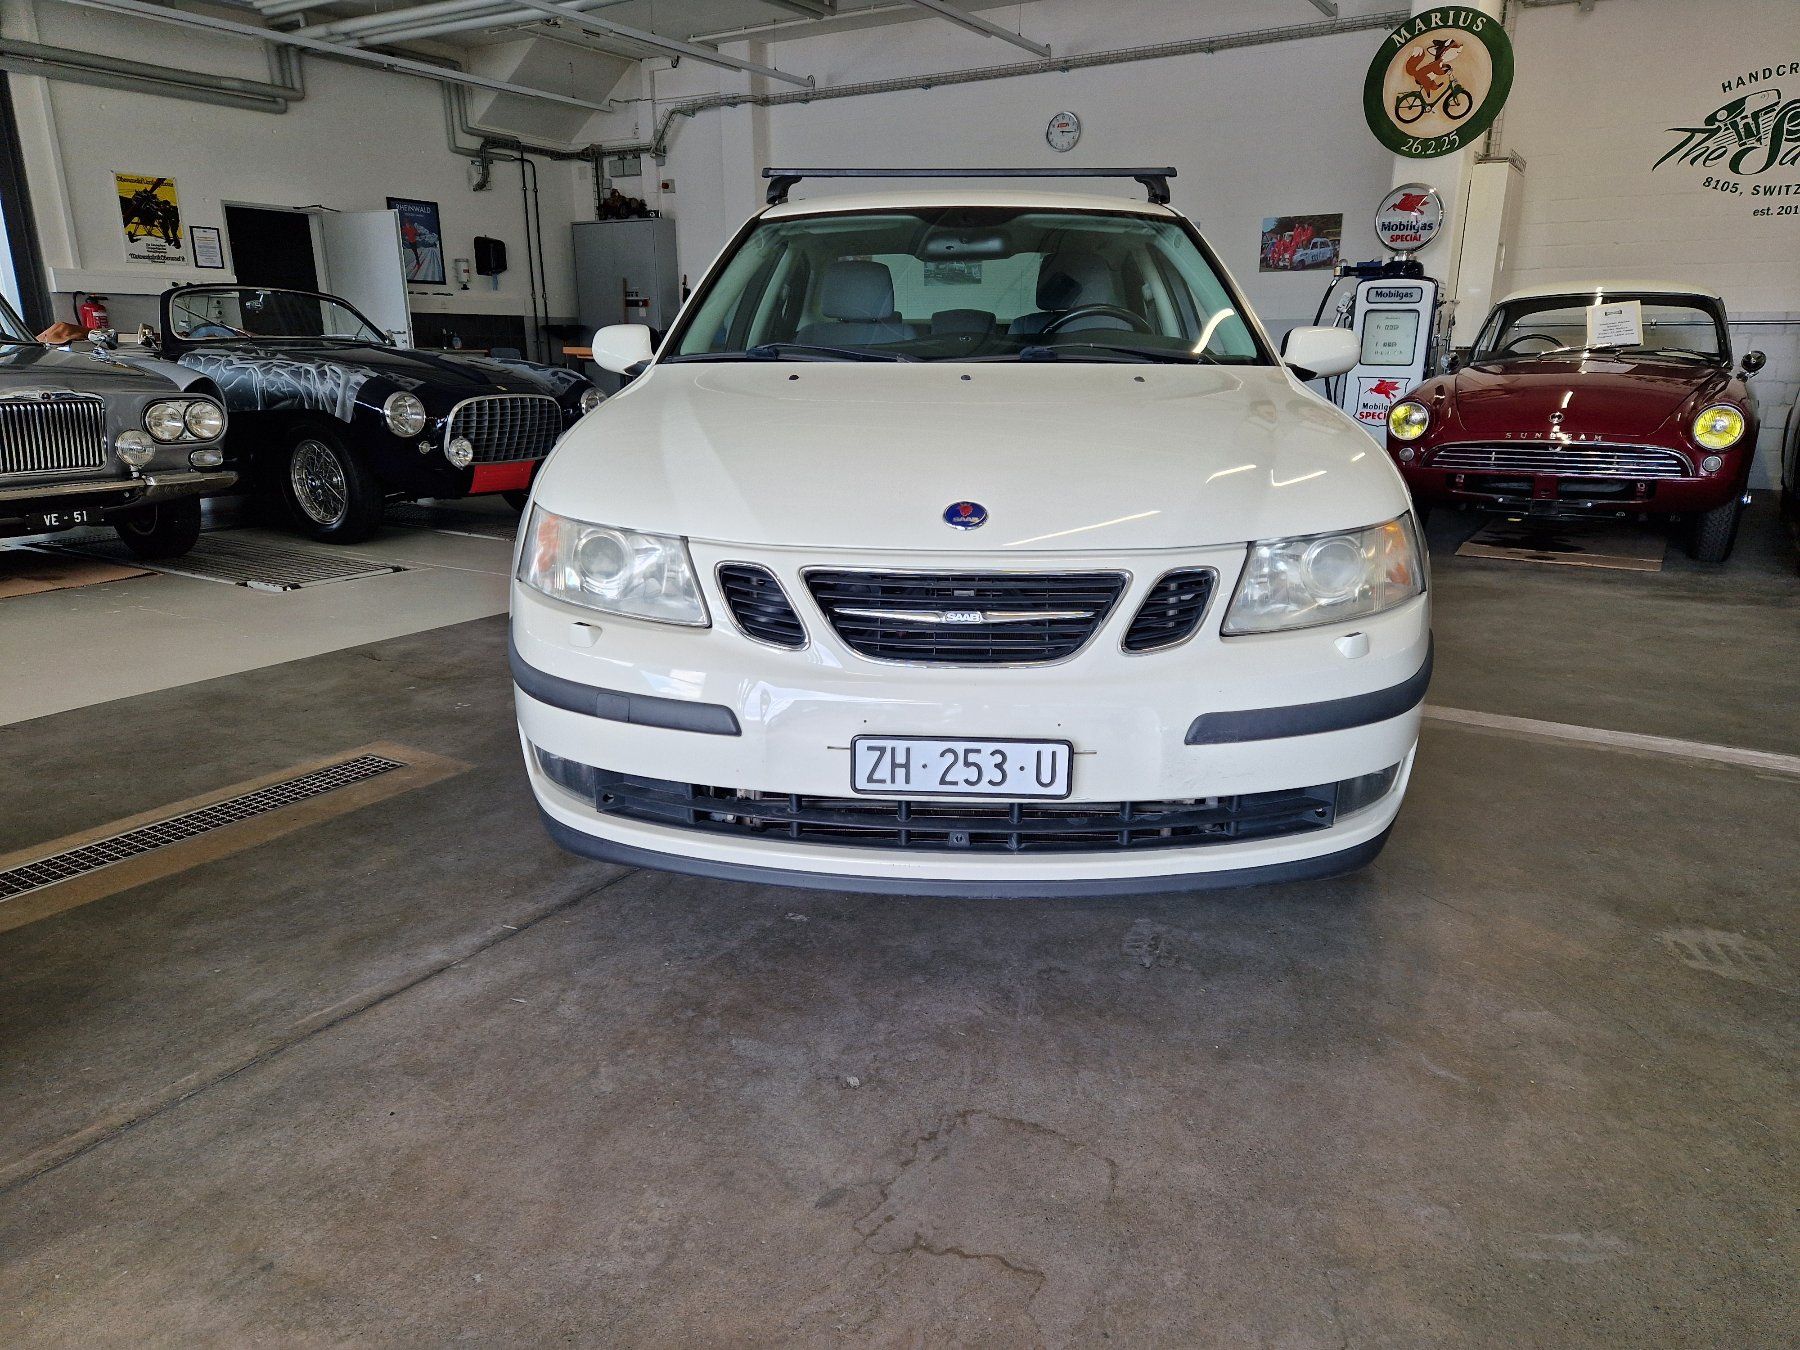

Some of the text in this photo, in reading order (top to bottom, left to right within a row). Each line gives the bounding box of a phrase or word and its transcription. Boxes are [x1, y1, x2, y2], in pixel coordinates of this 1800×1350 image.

[1391, 10, 1487, 48] MARIUS
[1401, 130, 1460, 155] 26.2.25
[1652, 124, 1728, 172] The
[1702, 176, 1744, 197] 8105,
[1752, 207, 1774, 217] est.
[1381, 221, 1434, 234] Mobilgas
[1374, 290, 1414, 300] Mobilgas
[43, 514, 59, 526] VE
[73, 510, 87, 523] 51
[946, 612, 980, 621] SAAB
